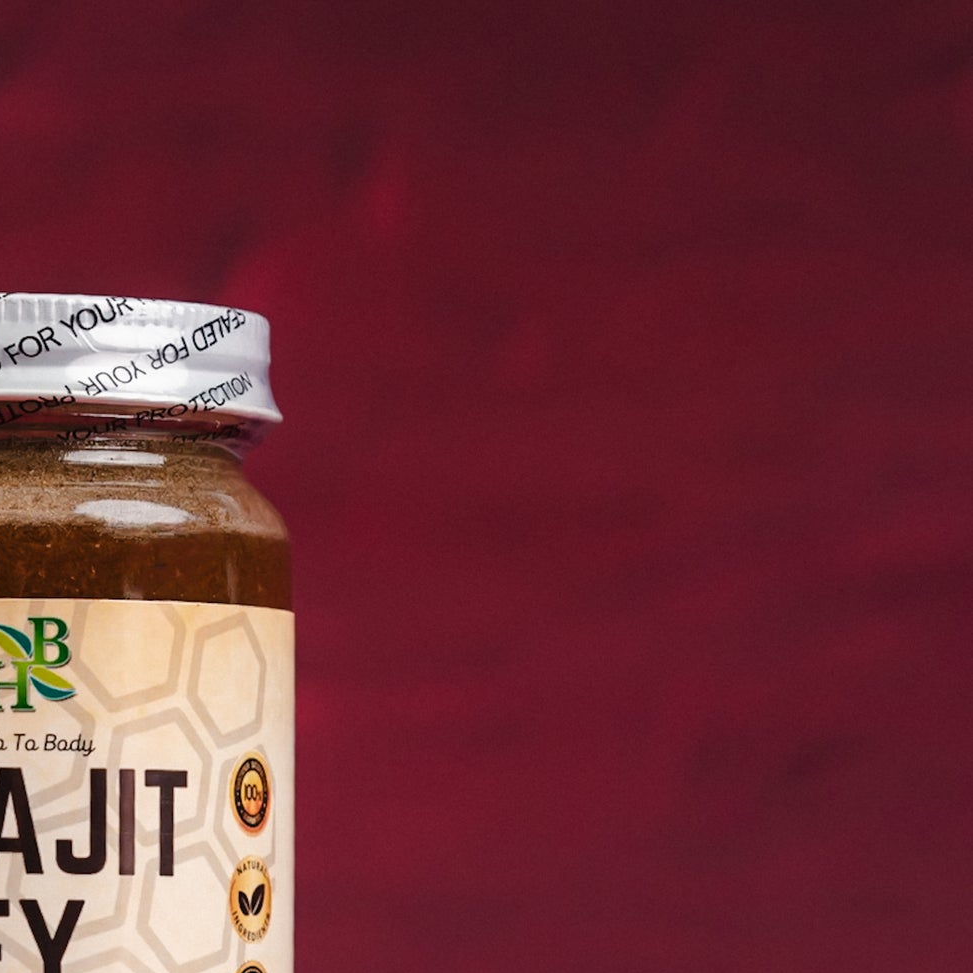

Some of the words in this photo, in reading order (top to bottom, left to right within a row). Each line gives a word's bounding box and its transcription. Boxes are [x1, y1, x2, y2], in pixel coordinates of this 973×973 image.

[3, 326, 63, 365] FOR
[59, 295, 134, 338] YOUR
[192, 309, 246, 352] SEALED
[147, 336, 190, 370] FOR
[78, 360, 147, 396] YOUR
[136, 371, 253, 427] PROTECTION
[13, 733, 39, 751] To
[44, 732, 96, 757] Body
